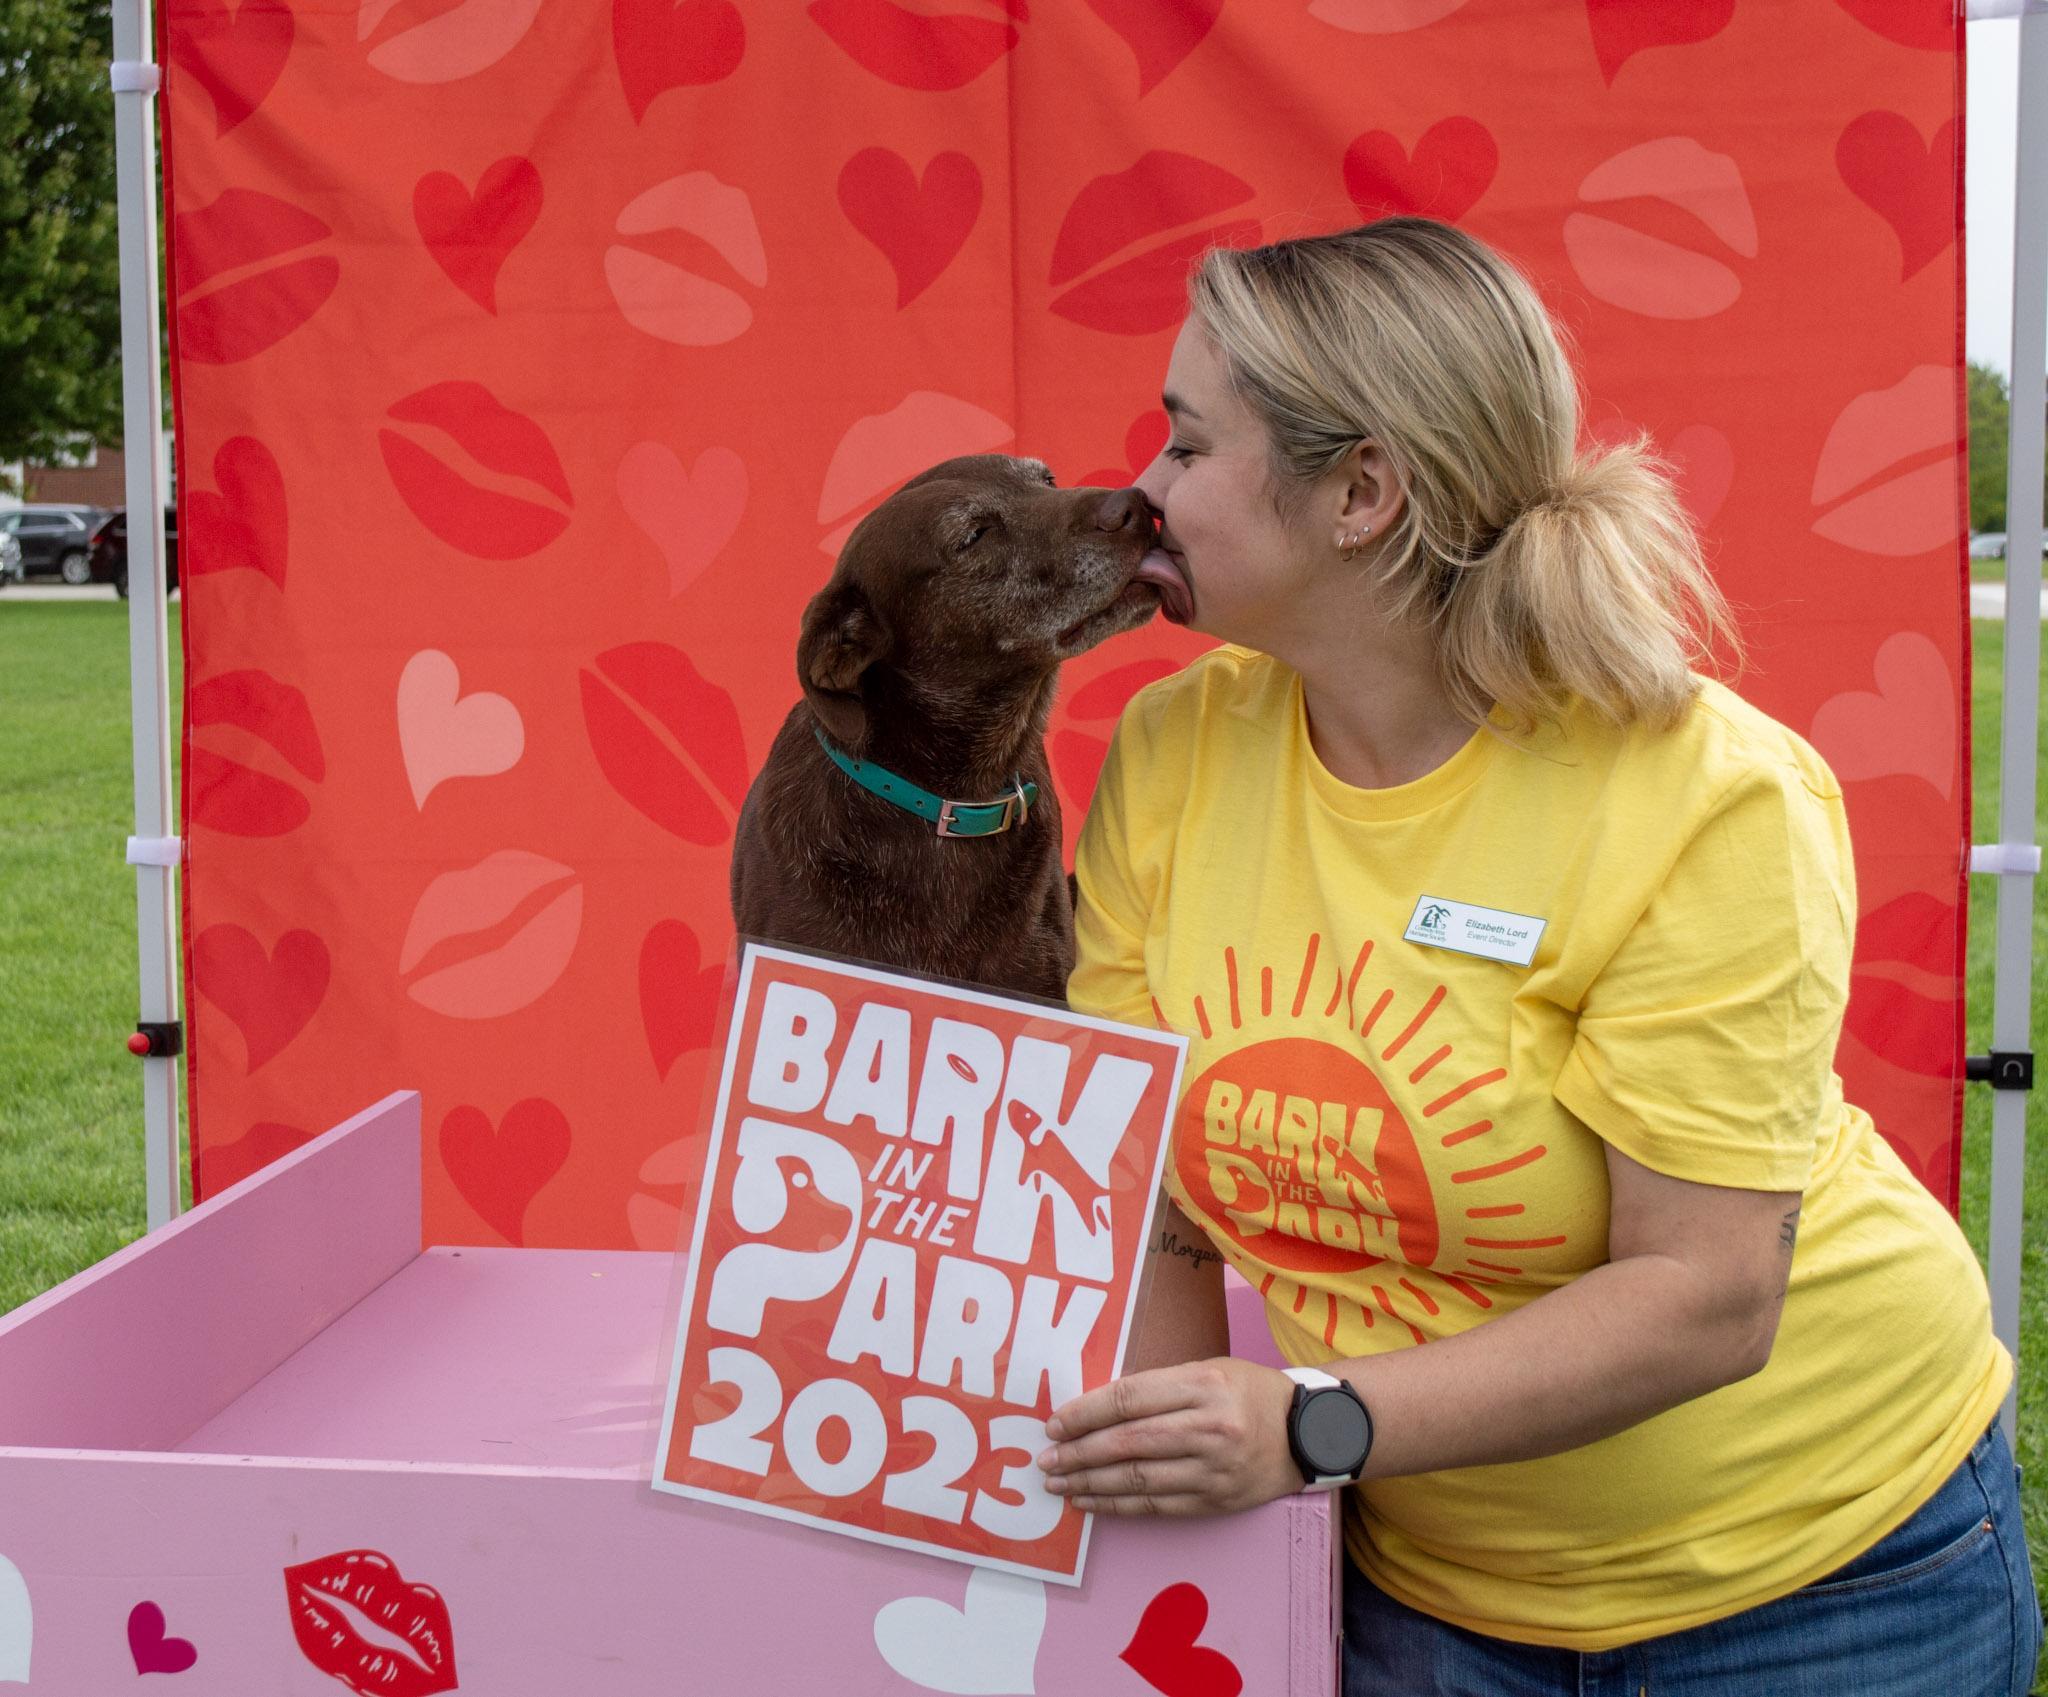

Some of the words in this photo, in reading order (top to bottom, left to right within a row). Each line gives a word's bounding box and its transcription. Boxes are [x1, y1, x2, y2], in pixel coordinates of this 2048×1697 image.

[1465, 919, 1505, 934] Elizabeth
[1507, 927, 1528, 939] Lord
[1466, 931, 1488, 943] Event
[1488, 935, 1517, 948] Director
[747, 981, 1154, 1283] BARK
[1204, 1079, 1398, 1219] BARK
[867, 1144, 935, 1191] IN
[1267, 1159, 1291, 1181] IN
[1276, 1180, 1319, 1204] THE
[867, 1194, 973, 1247] THE
[706, 1116, 1108, 1411] PARK
[1148, 1231, 1225, 1269] Morgan
[689, 1346, 1065, 1541] 2023
